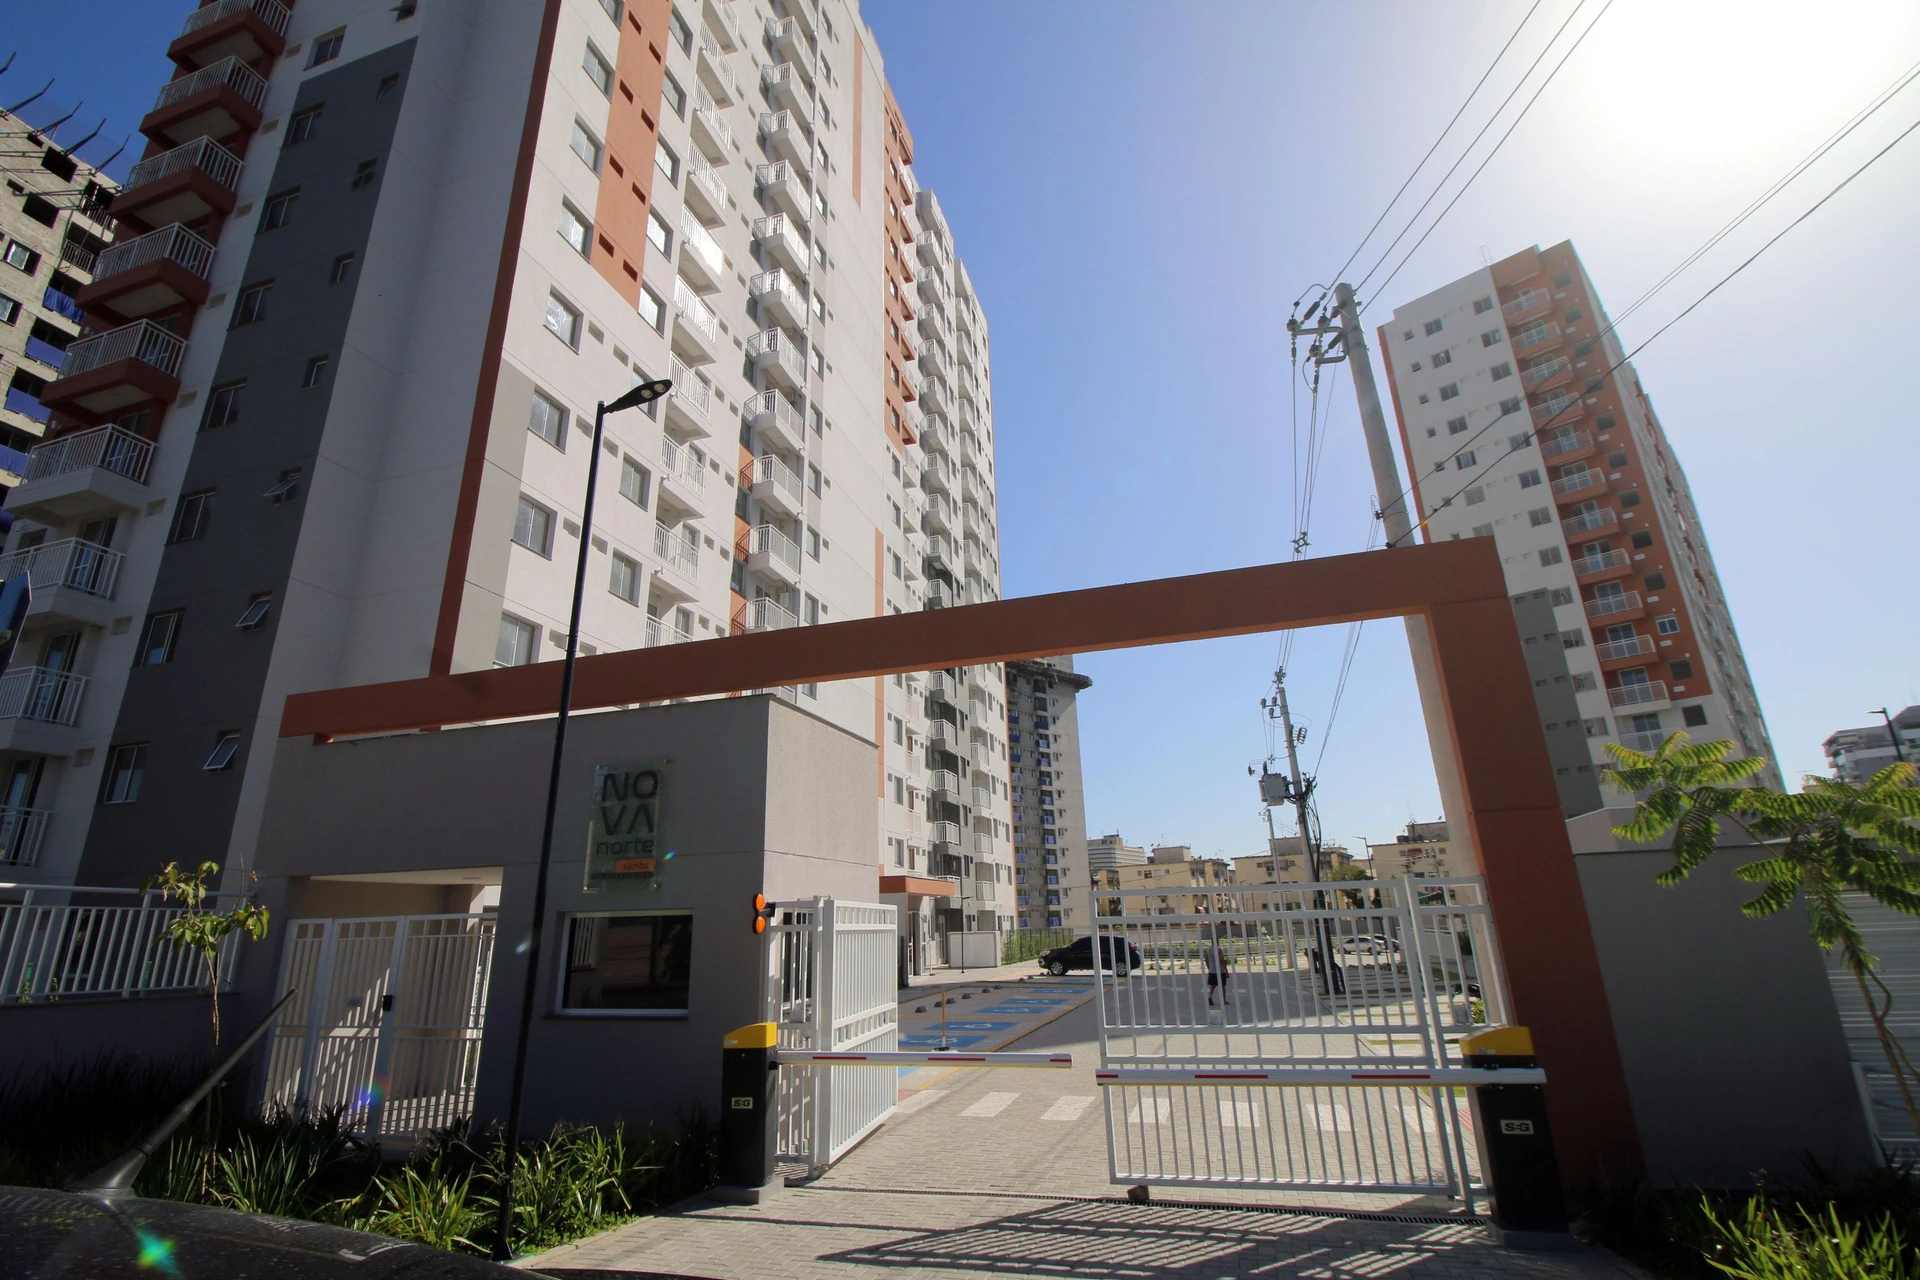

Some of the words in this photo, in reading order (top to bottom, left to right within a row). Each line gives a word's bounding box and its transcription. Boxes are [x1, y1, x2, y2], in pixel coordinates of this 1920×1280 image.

[601, 770, 658, 802] NO
[596, 838, 654, 856] norte
[623, 862, 650, 870] samba
